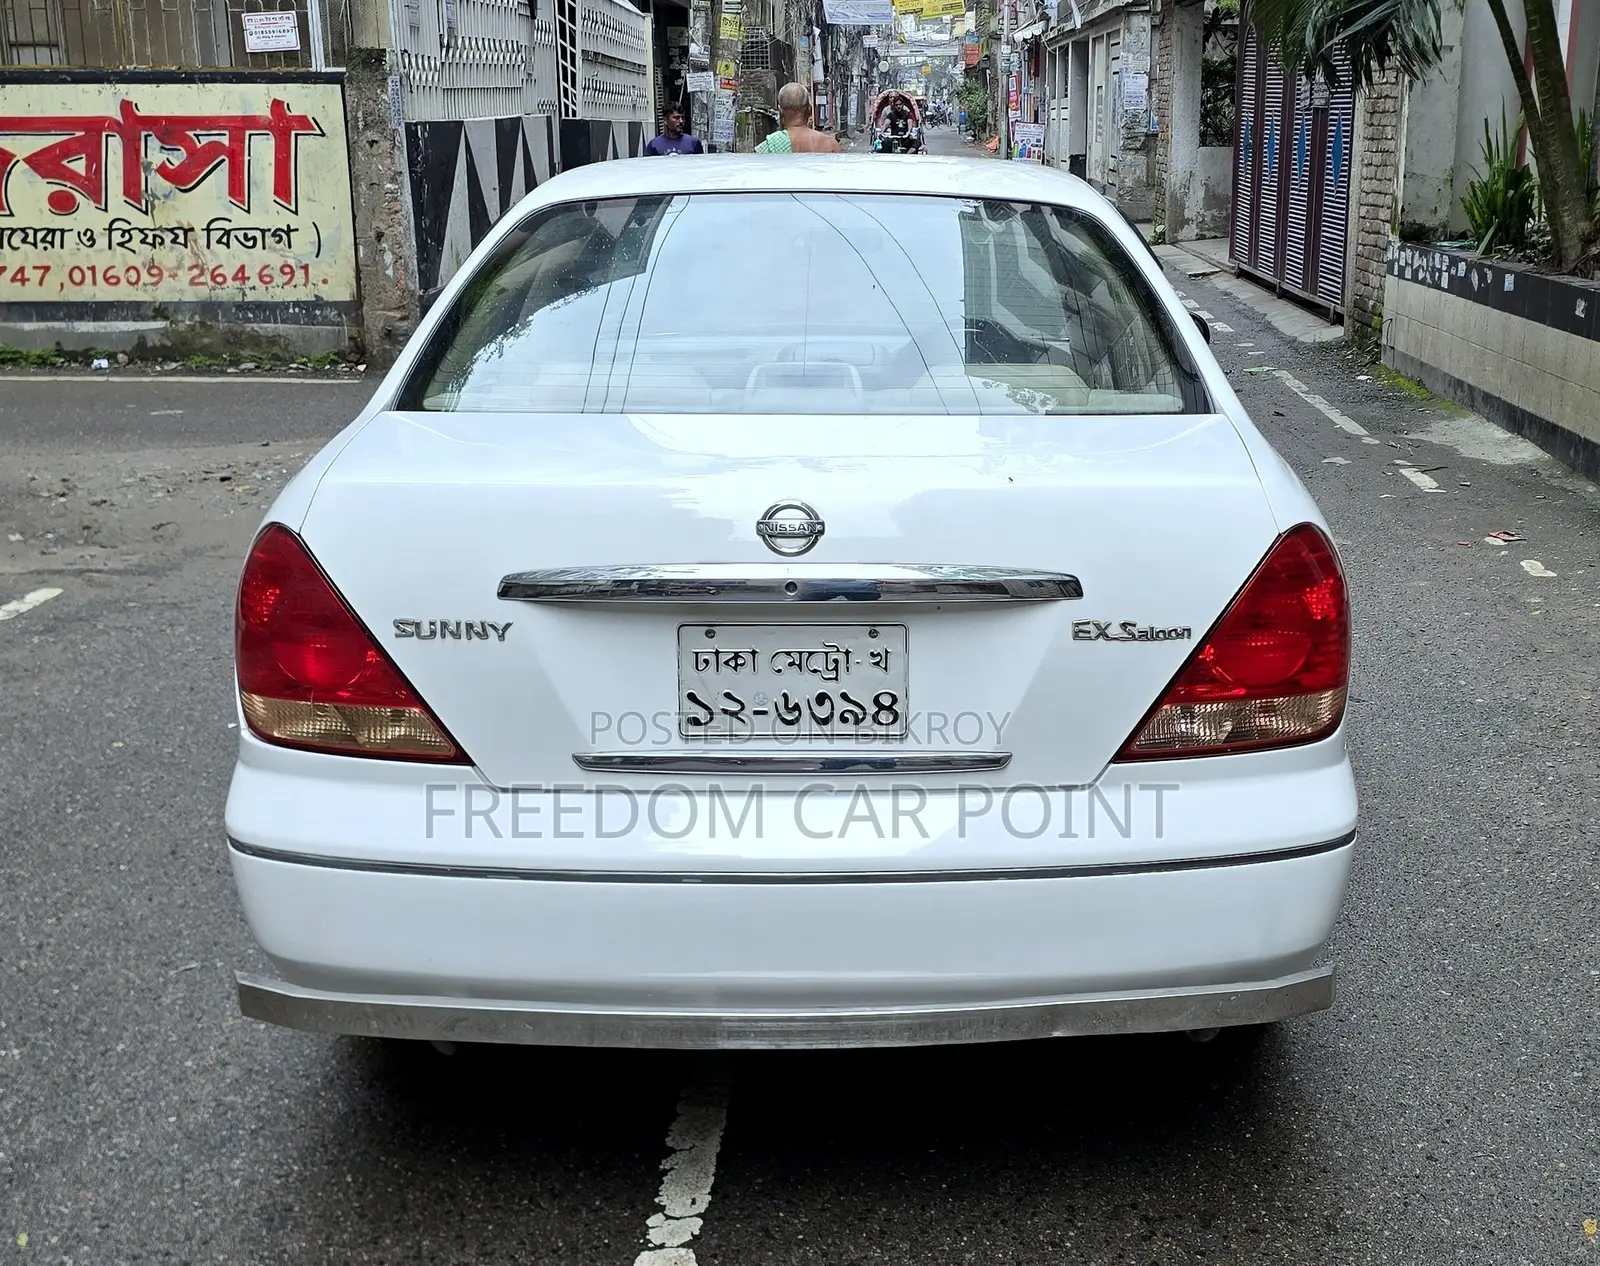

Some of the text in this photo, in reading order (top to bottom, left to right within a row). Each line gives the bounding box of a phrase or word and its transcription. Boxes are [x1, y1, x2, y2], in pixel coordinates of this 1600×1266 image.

[77, 228, 97, 248] ও
[103, 218, 195, 254] হিফয
[201, 217, 299, 250] বিভাগ
[763, 523, 819, 532] NISSAN
[393, 619, 514, 642] SUNNY
[692, 645, 760, 674] ঢাকা
[685, 689, 900, 727] ১২-৬৩৯৪
